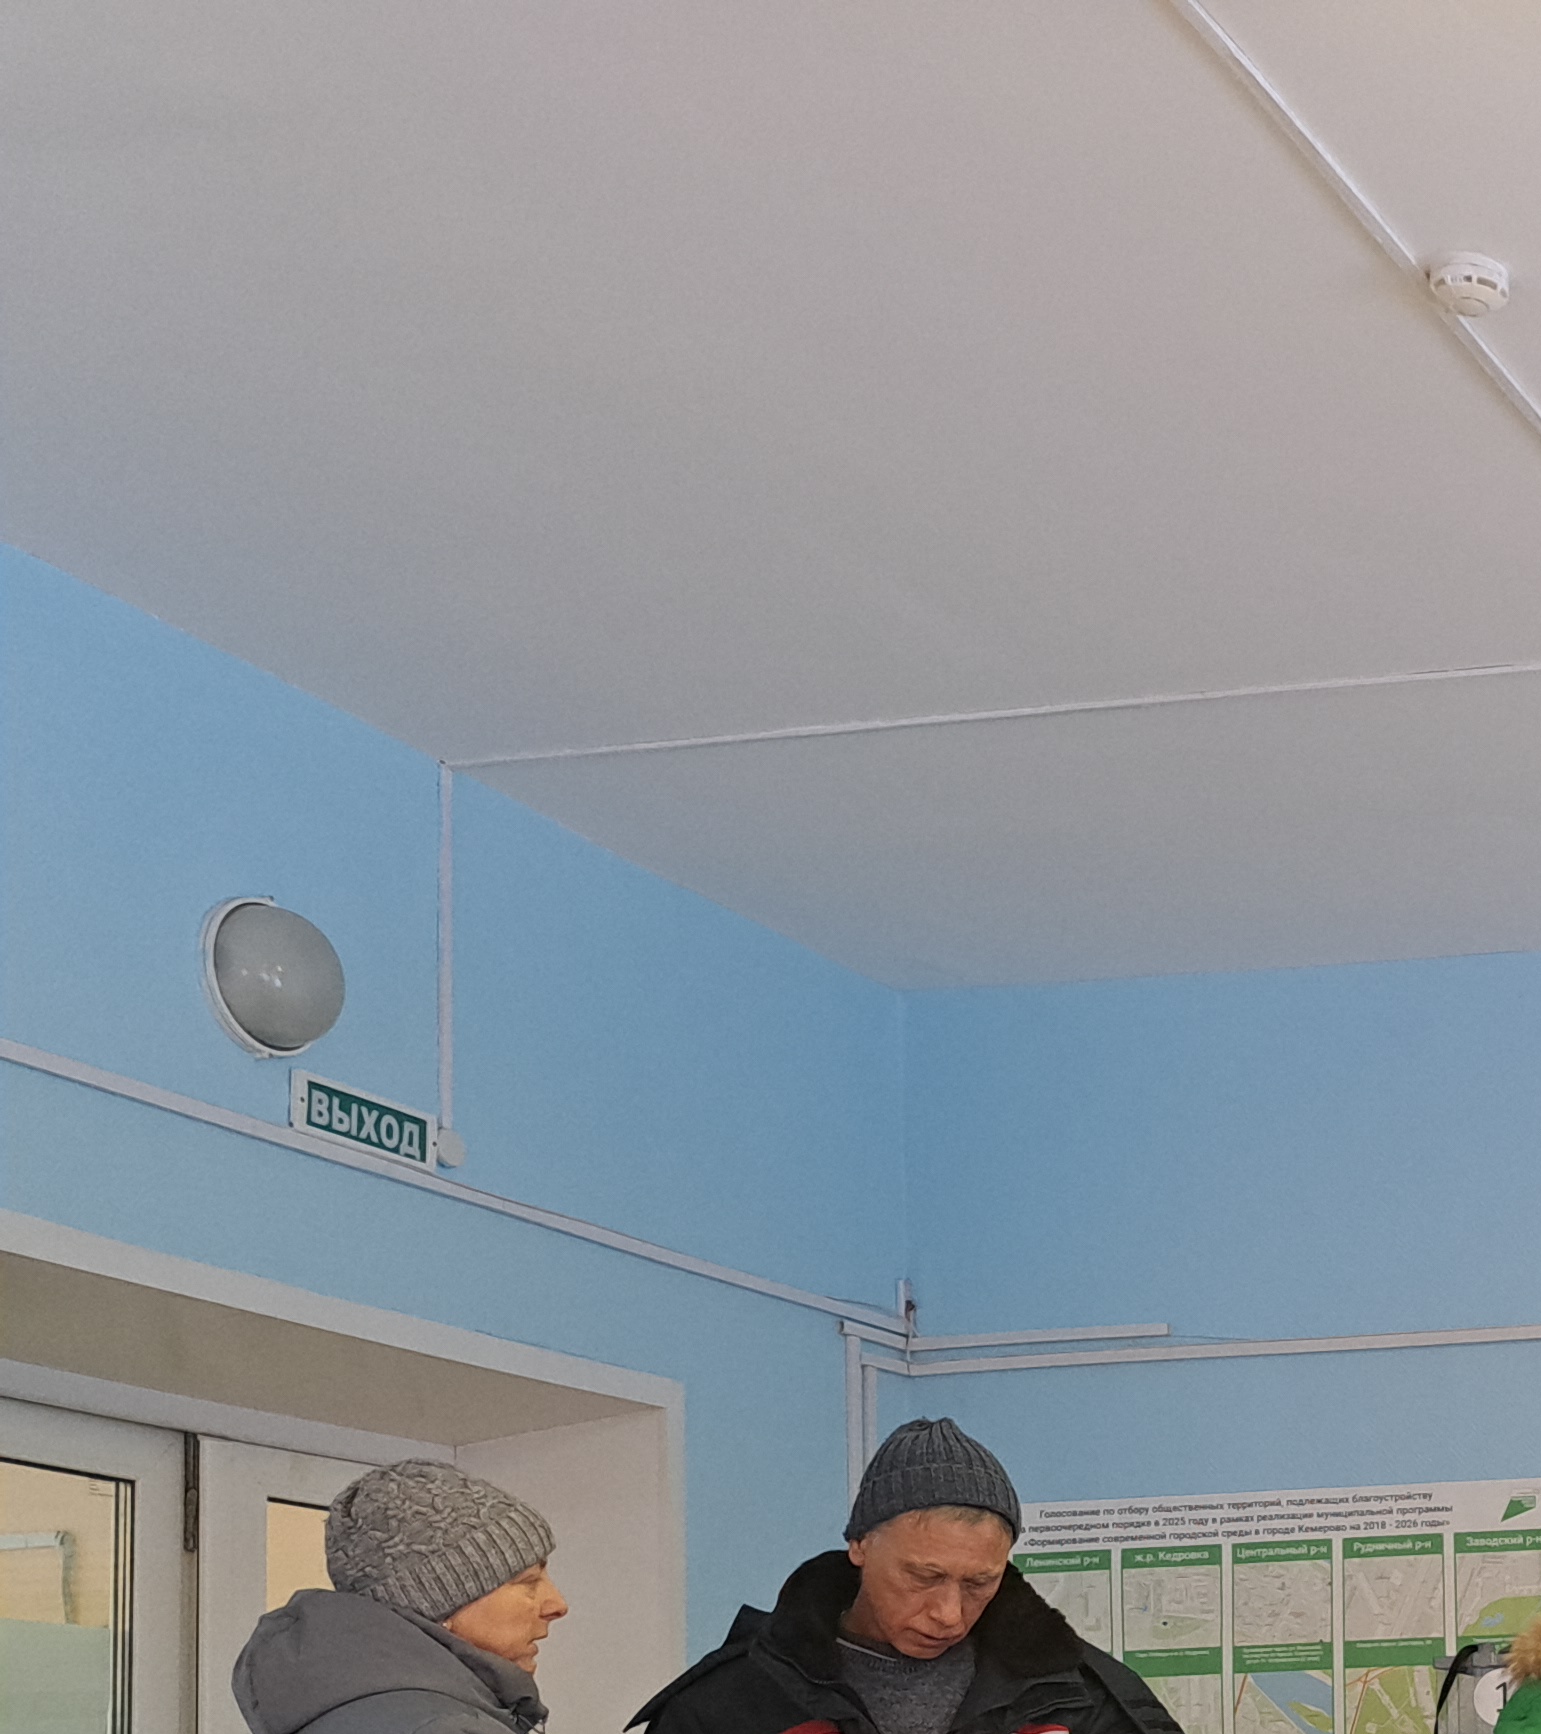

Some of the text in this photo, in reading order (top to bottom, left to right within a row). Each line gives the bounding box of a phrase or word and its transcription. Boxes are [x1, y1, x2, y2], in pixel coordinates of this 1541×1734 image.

[310, 1089, 423, 1160] ВЫХОД
[1039, 1508, 1100, 1519] Голосование
[1103, 1509, 1115, 1517] по
[1117, 1506, 1149, 1517] отбору
[1152, 1503, 1224, 1514] общественных
[1286, 1496, 1349, 1507] подлежащих
[1352, 1491, 1433, 1504] благоустройству
[1112, 1520, 1151, 1531] порядке
[1162, 1516, 1186, 1526] 2025
[1188, 1516, 1209, 1527] году
[1220, 1514, 1254, 1525] рамках
[1396, 1504, 1453, 1516] программы
[1169, 1529, 1219, 1541] городской
[1221, 1528, 1252, 1538] среды
[1262, 1526, 1296, 1537] городе
[1297, 1523, 1347, 1535] Кемерово
[1349, 1523, 1361, 1531] на
[1363, 1521, 1387, 1531] 2018
[1395, 1519, 1419, 1529] 2026
[1353, 1539, 1432, 1553] Рудничный р-н
[1466, 1534, 1524, 1547] Заводский
[1158, 1550, 1209, 1561] Кедровка
[1236, 1544, 1327, 1559] Центральный р-н
[1026, 1555, 1100, 1568] Ленинский р-н
